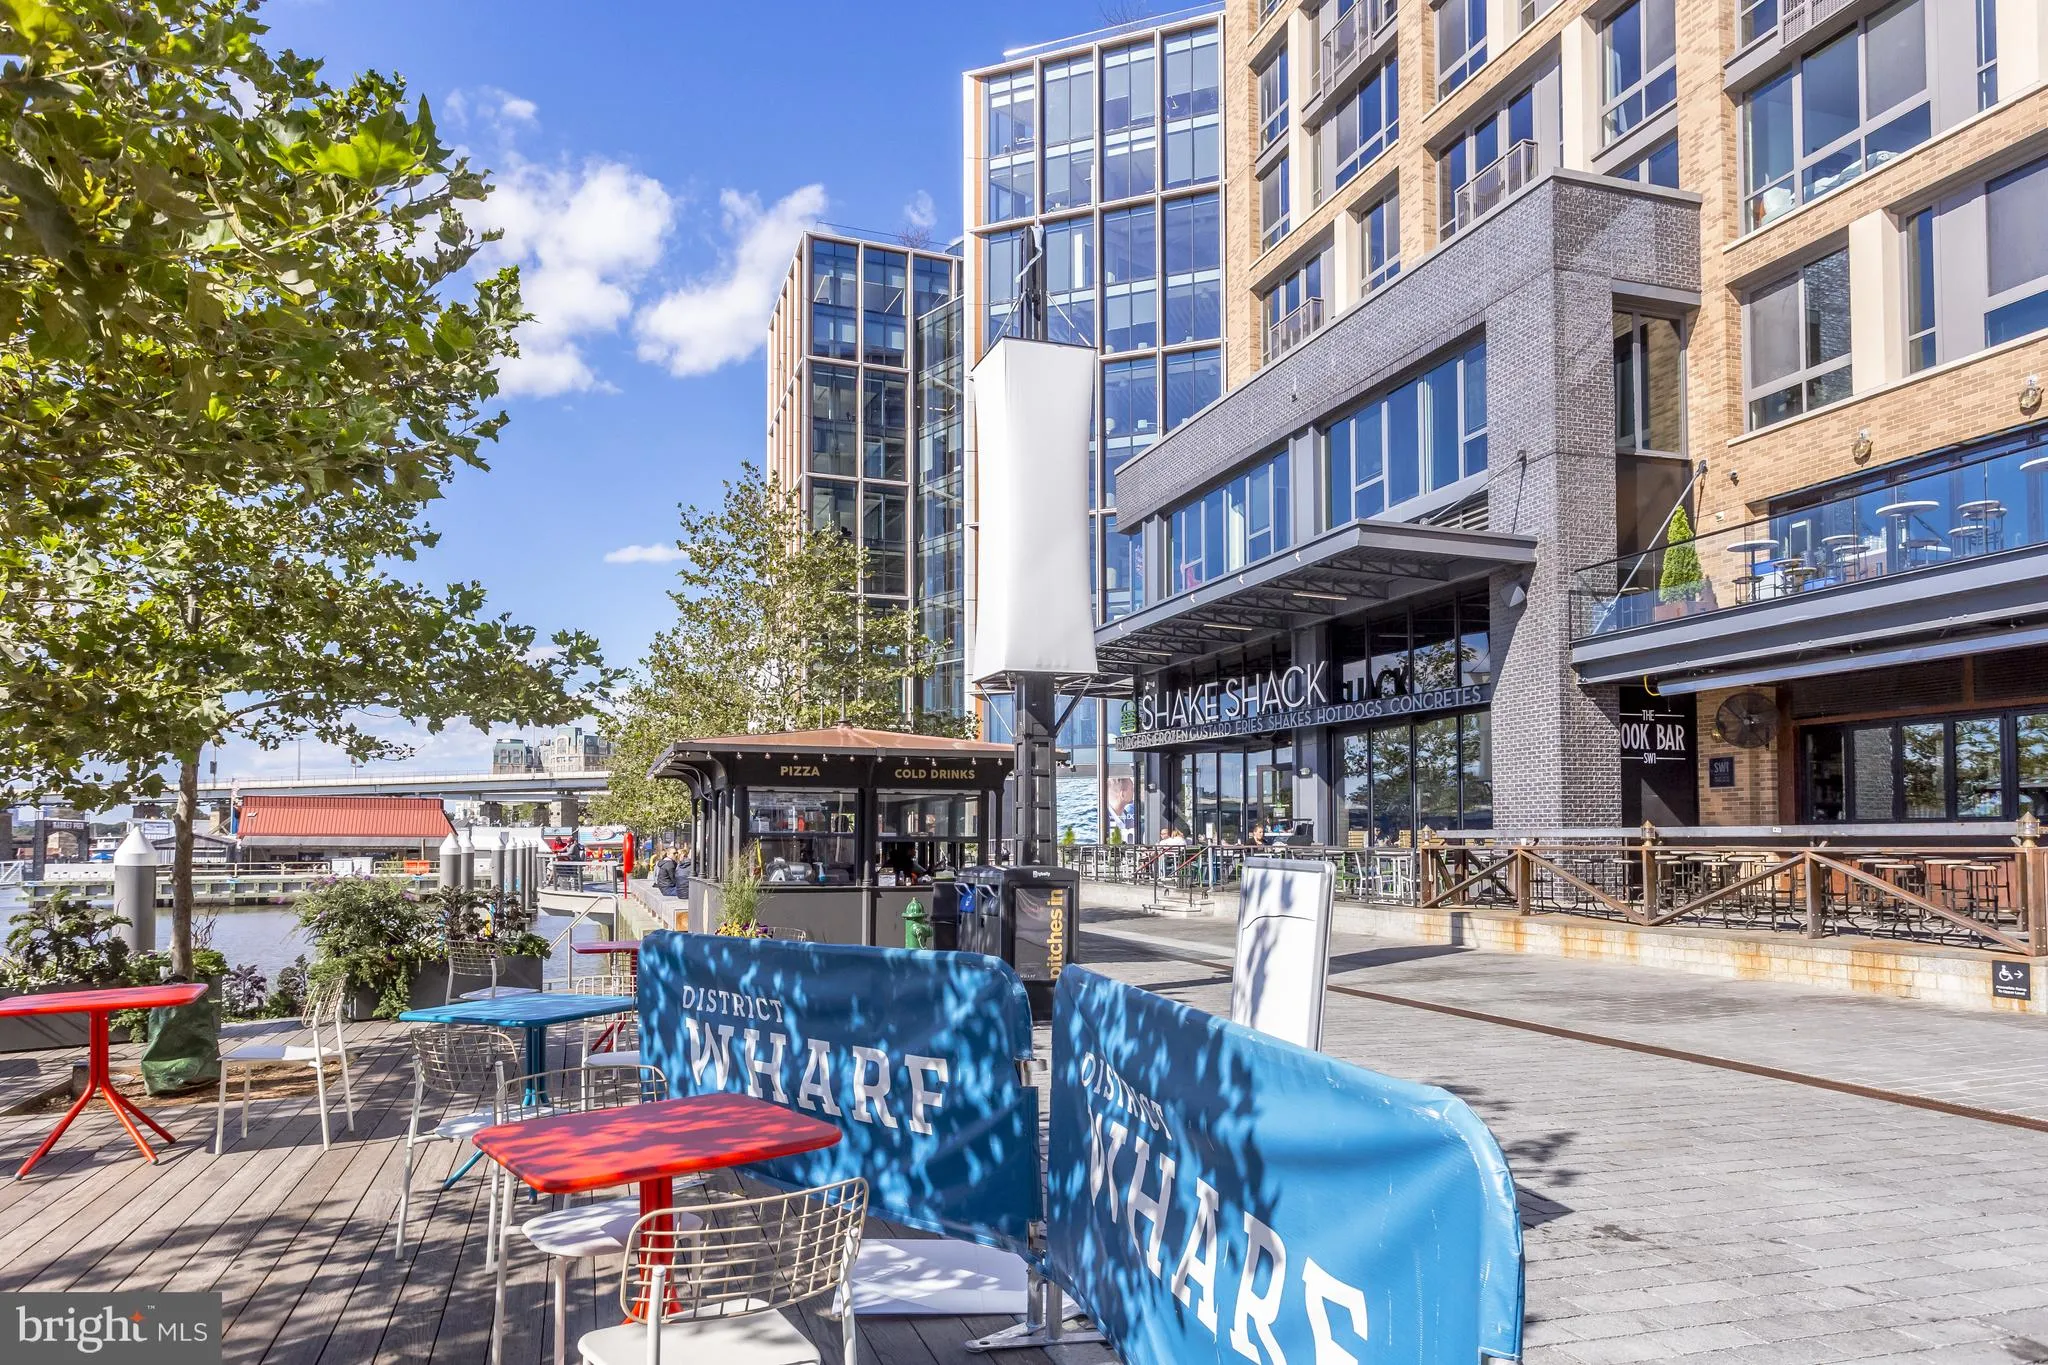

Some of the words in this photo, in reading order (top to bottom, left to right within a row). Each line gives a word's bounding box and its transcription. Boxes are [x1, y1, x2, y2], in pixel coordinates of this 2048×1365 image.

[1142, 682, 1220, 731] SHAKE
[1225, 661, 1327, 717] SHACK
[1153, 729, 1188, 745] FROZEN
[1189, 722, 1231, 739] CUSTARD
[1235, 717, 1263, 735] FRIES
[1268, 710, 1311, 729] SHAKES
[1317, 705, 1343, 724] HOT
[1345, 700, 1382, 720] DOGS
[1390, 686, 1481, 714] CONCRETES
[1642, 709, 1655, 721] THE
[1619, 723, 1651, 750] OOK
[1656, 723, 1686, 751] BAR
[780, 766, 820, 777] PIZZA
[894, 769, 925, 780] COLD
[930, 769, 976, 780] DRINKS
[1046, 889, 1064, 906] in
[1046, 908, 1064, 980] pitches
[682, 985, 783, 1024] DISTRICT
[685, 1017, 950, 1136] WHARF
[1080, 1051, 1172, 1141] DISTRICT
[1087, 1103, 1368, 1365] WHARF
